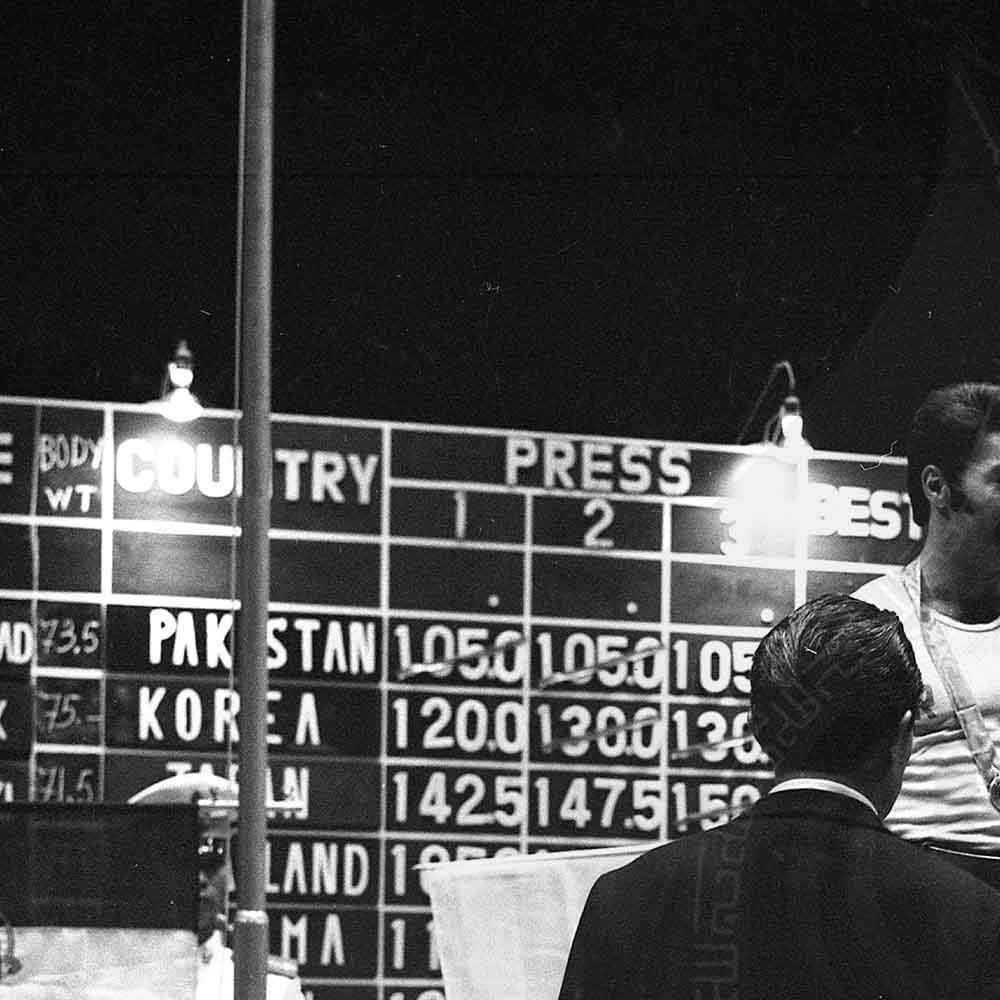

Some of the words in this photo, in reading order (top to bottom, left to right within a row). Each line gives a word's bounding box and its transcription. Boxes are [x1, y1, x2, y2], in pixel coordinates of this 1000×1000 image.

[40, 434, 102, 471] BODY
[115, 437, 379, 505] COUTRY
[506, 437, 692, 495] PRESS
[583, 499, 615, 548] 2
[149, 608, 376, 676] PAKSTAN
